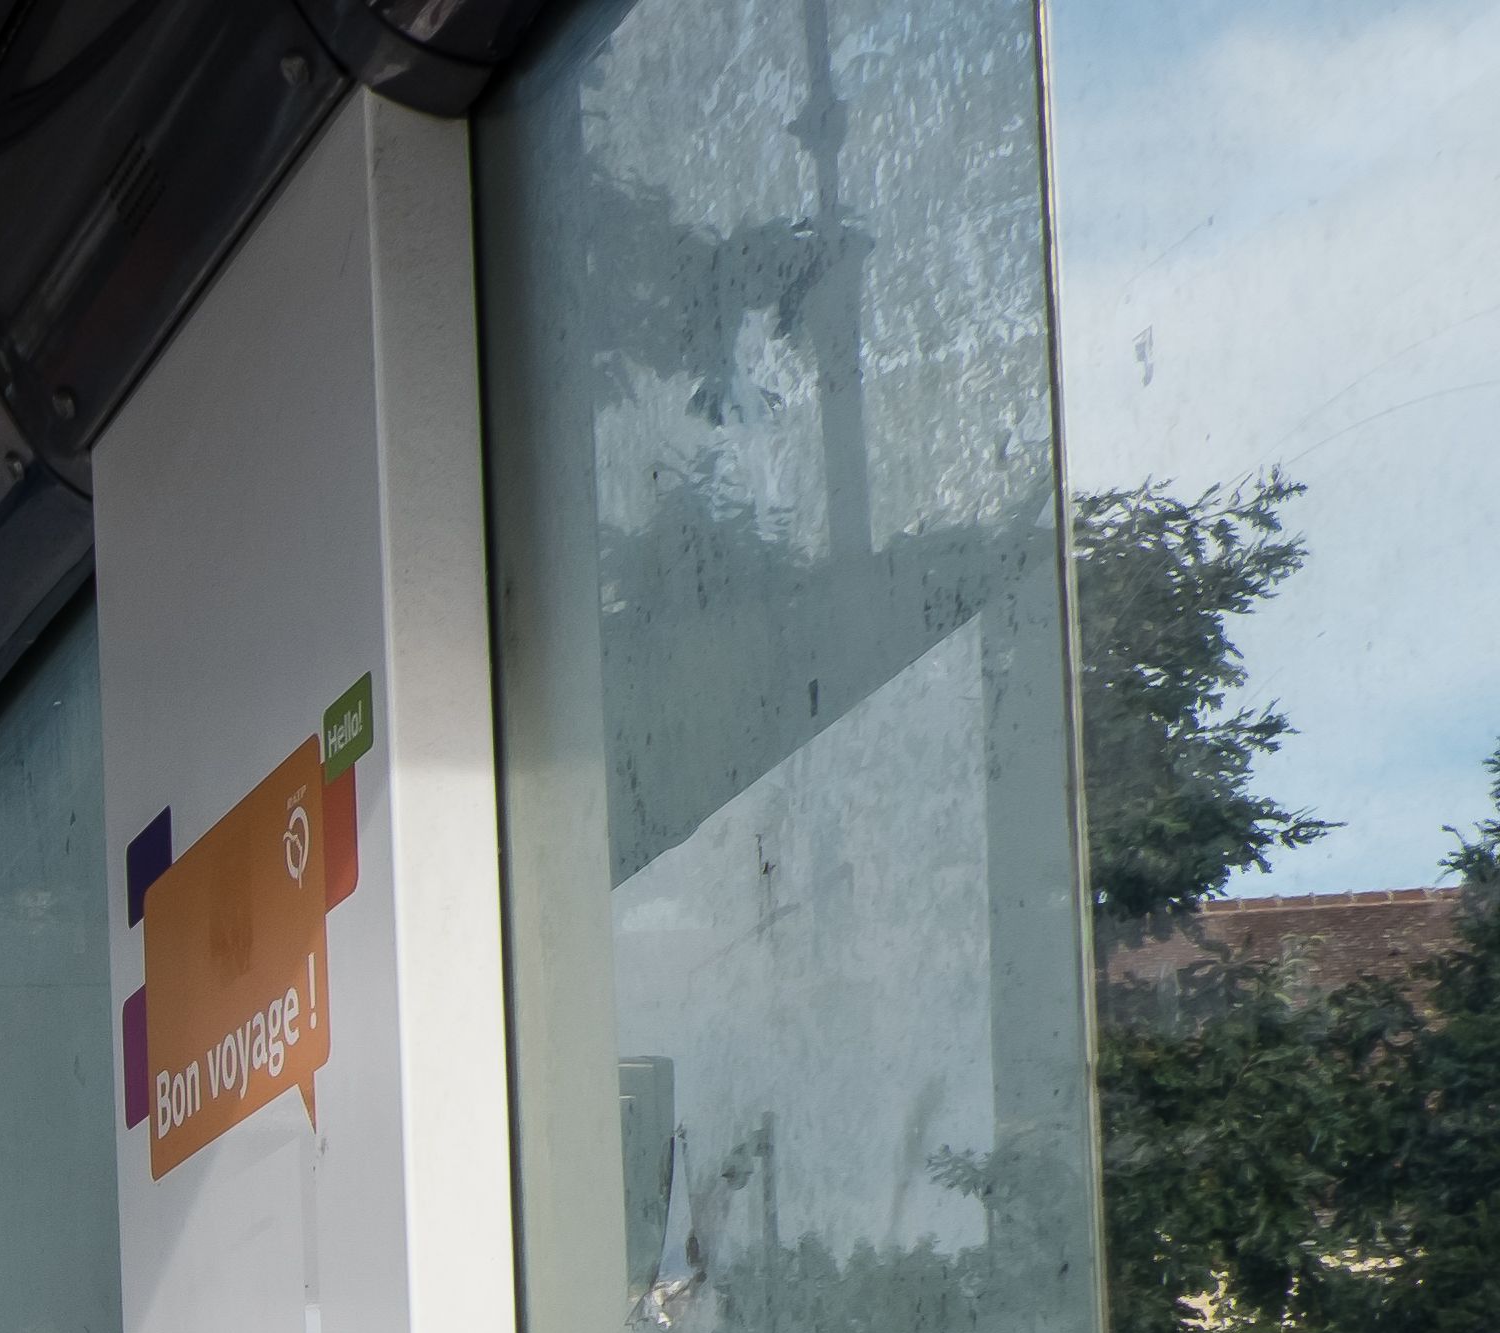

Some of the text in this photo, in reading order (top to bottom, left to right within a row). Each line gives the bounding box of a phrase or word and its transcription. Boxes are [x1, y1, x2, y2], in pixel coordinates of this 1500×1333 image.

[327, 699, 364, 759] Hello!
[155, 1058, 202, 1140] Bon
[207, 985, 300, 1099] voyage
